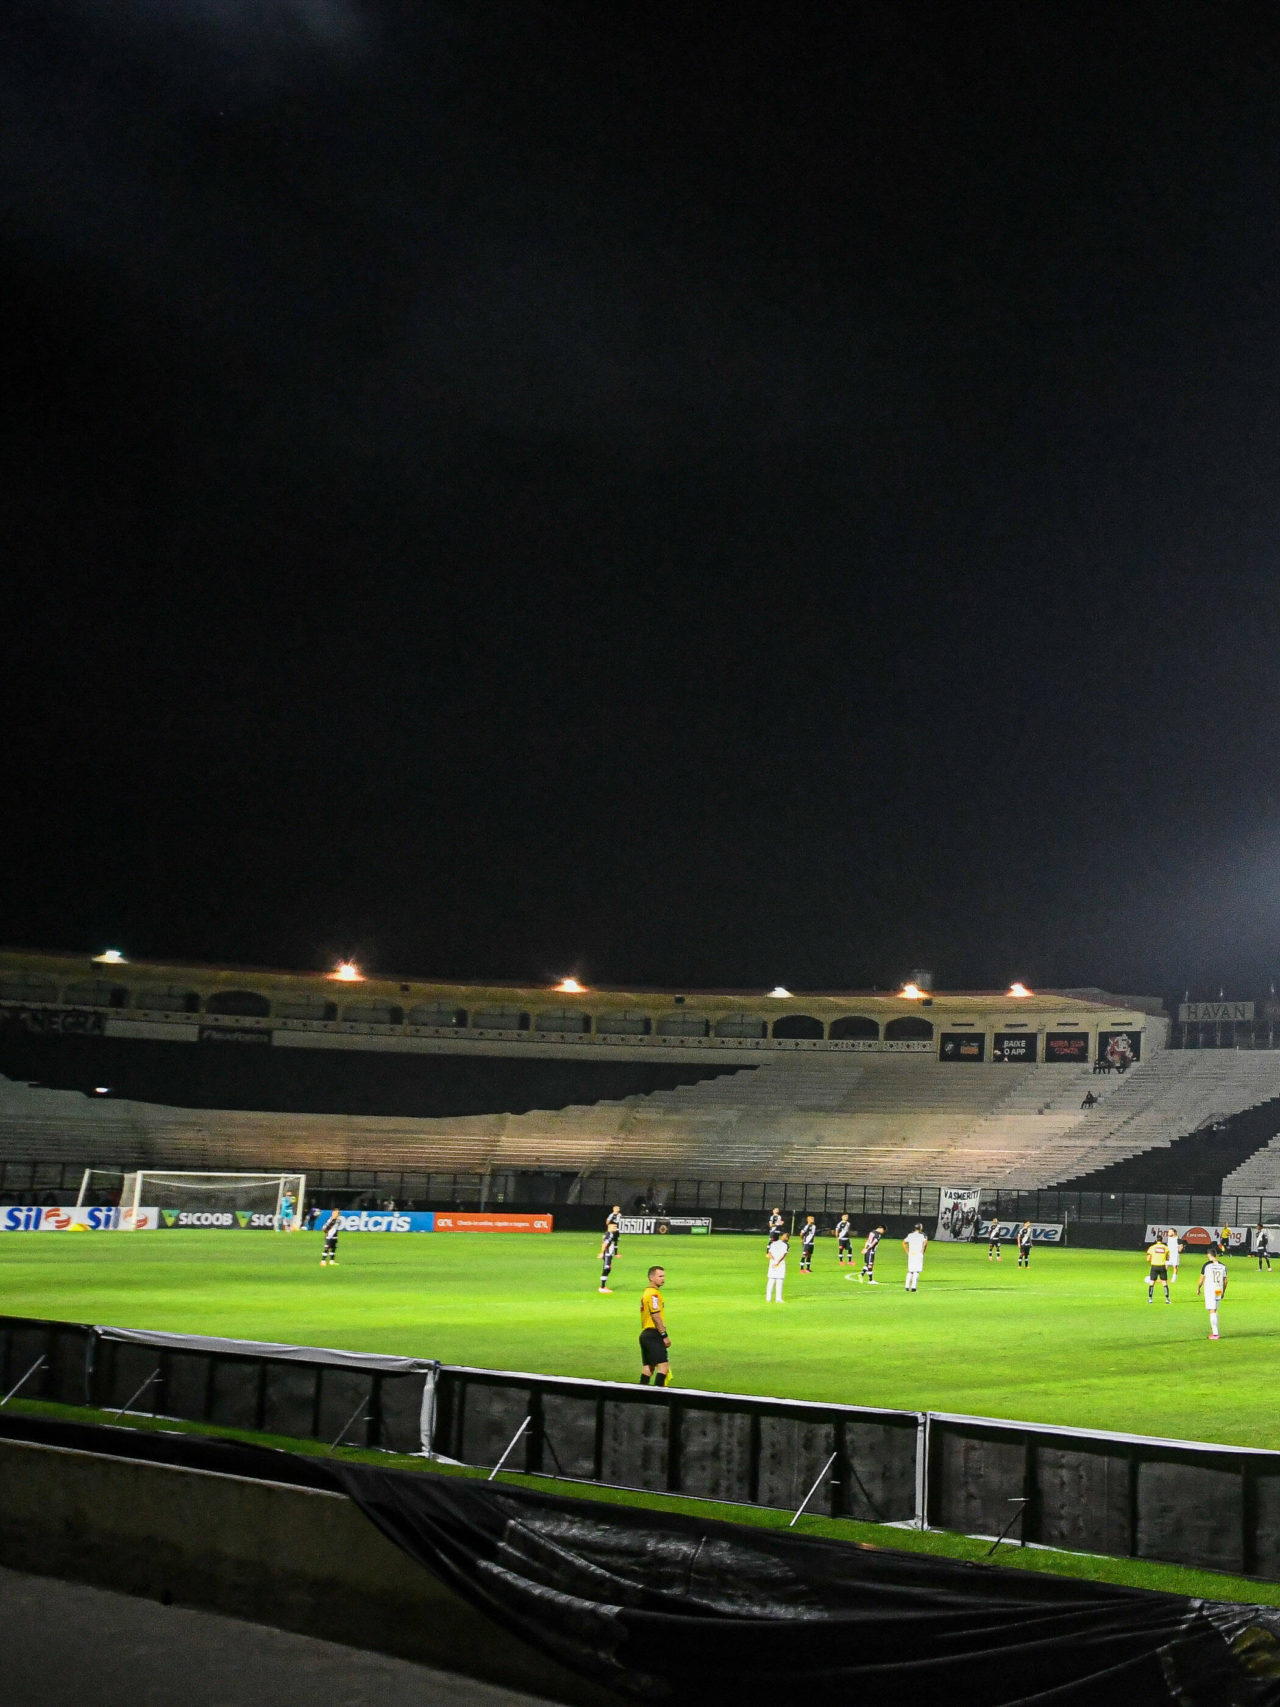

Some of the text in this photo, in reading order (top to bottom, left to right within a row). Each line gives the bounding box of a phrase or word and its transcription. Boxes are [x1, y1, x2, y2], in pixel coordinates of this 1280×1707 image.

[1186, 1003, 1246, 1019] HAVAN
[1003, 1040, 1026, 1048] BAIXE
[5, 1207, 42, 1231] Sil
[87, 1207, 120, 1230] Sil
[178, 1213, 233, 1226] SICOOB
[618, 1218, 656, 1234] OSSO CT
[977, 1220, 1057, 1240] bolve
[1212, 1270, 1222, 1284] 12
